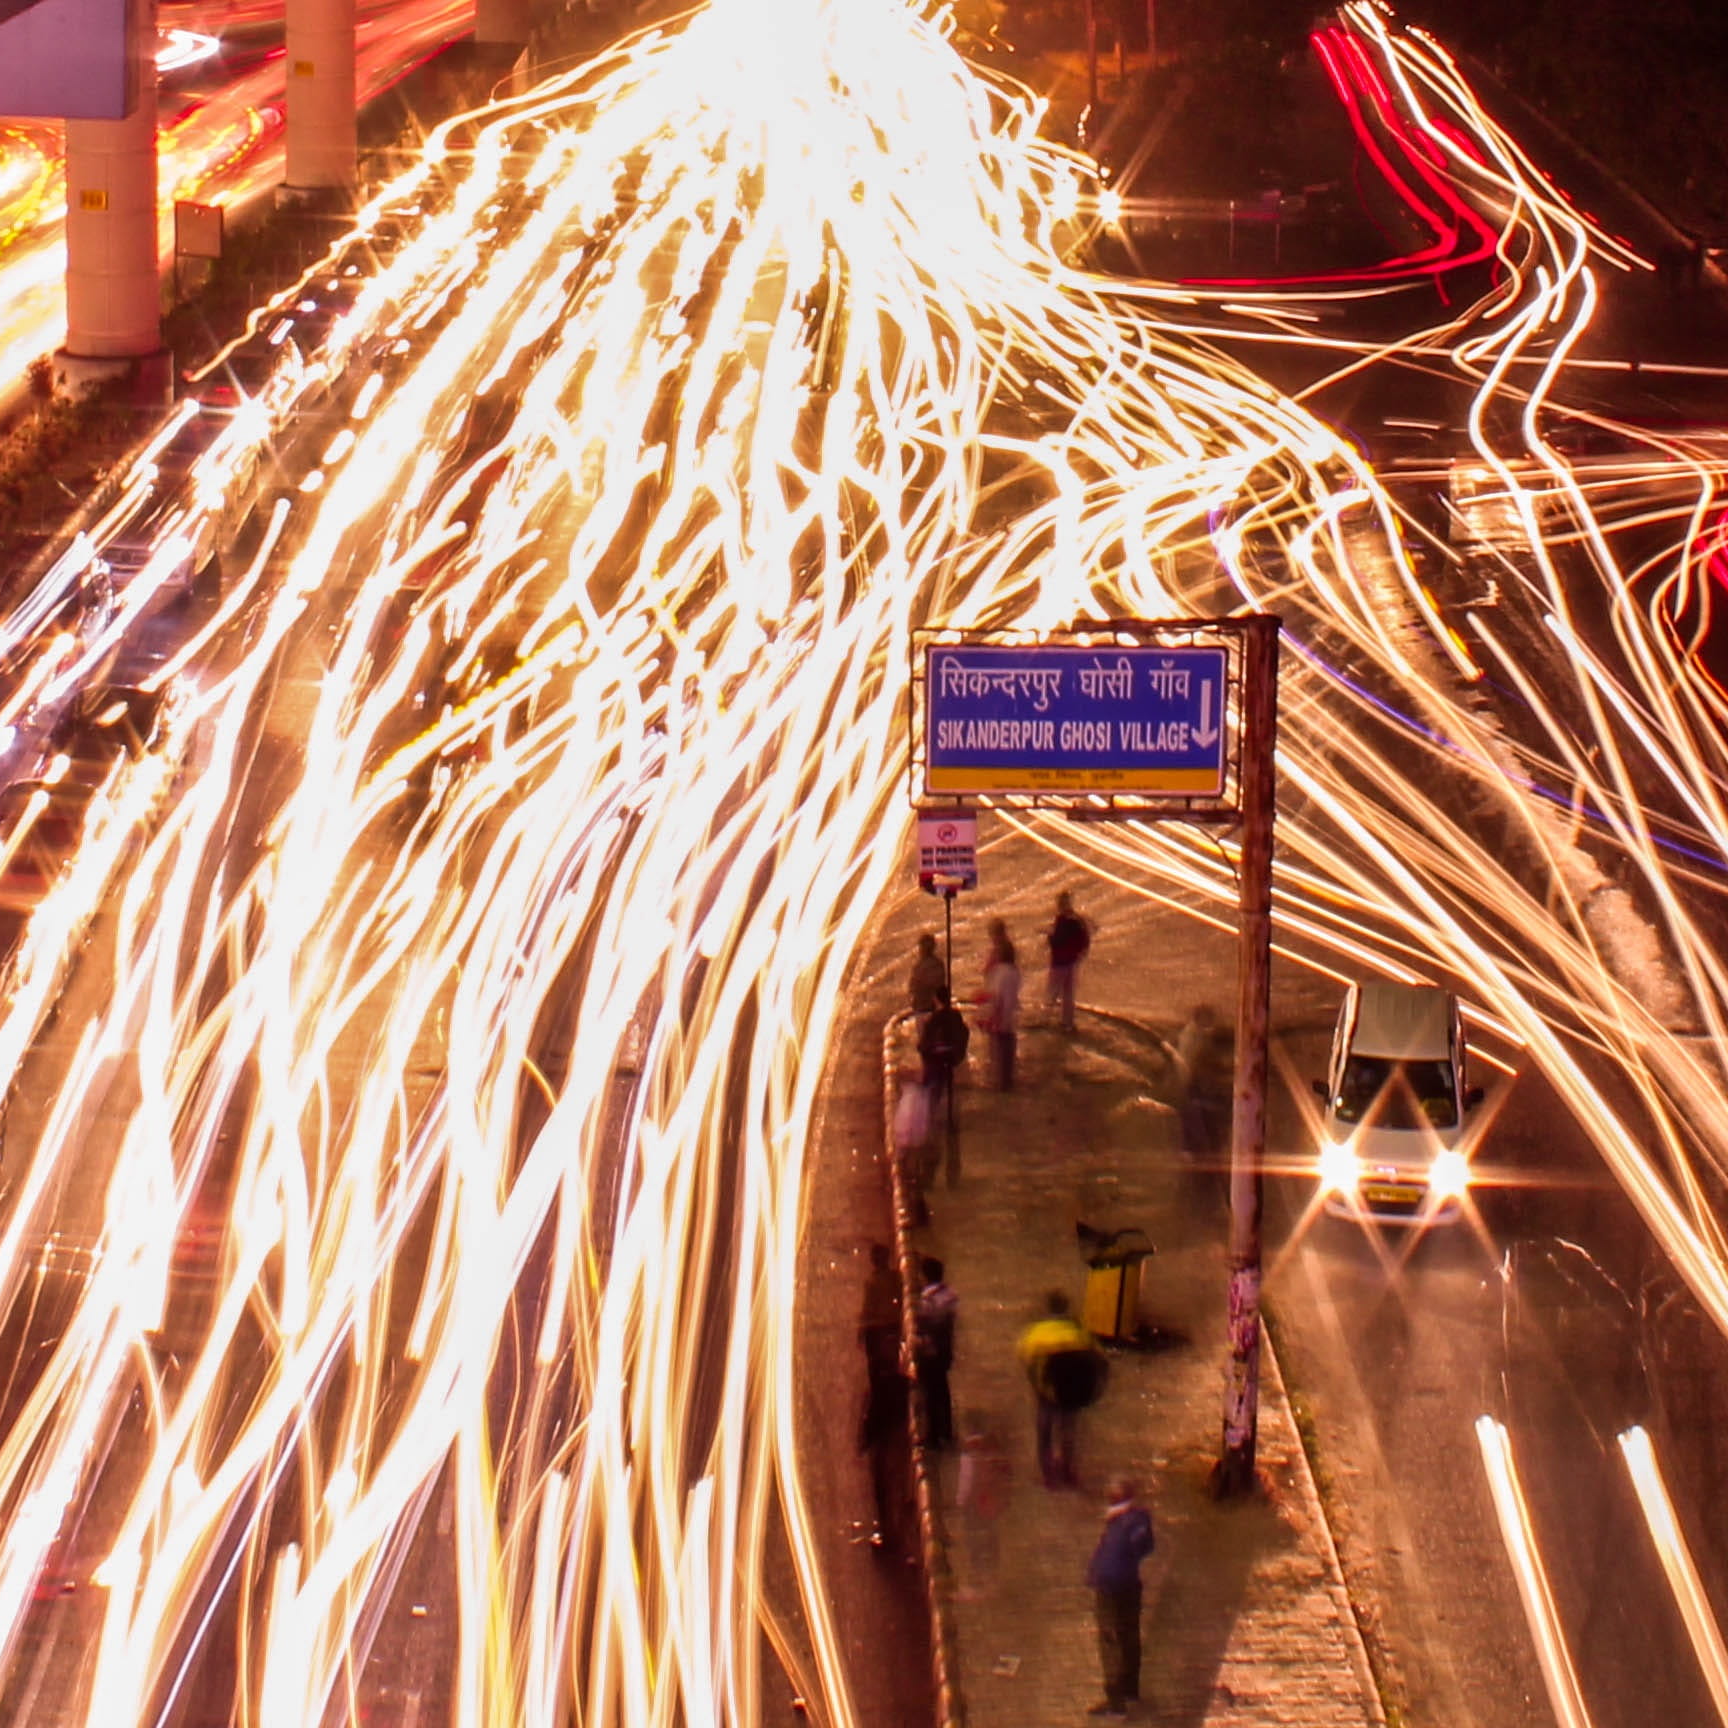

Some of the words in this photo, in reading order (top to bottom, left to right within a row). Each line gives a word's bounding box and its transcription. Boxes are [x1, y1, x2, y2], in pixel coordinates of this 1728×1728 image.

[939, 656, 1062, 712] सिकन्दरपुर
[1078, 656, 1134, 700] घोसी
[937, 720, 1055, 750] SIKANDERPUR
[1060, 720, 1111, 751] GHOSI
[1119, 721, 1189, 751] VILLAGE
[921, 847, 934, 856] NO
[921, 858, 934, 867] NO
